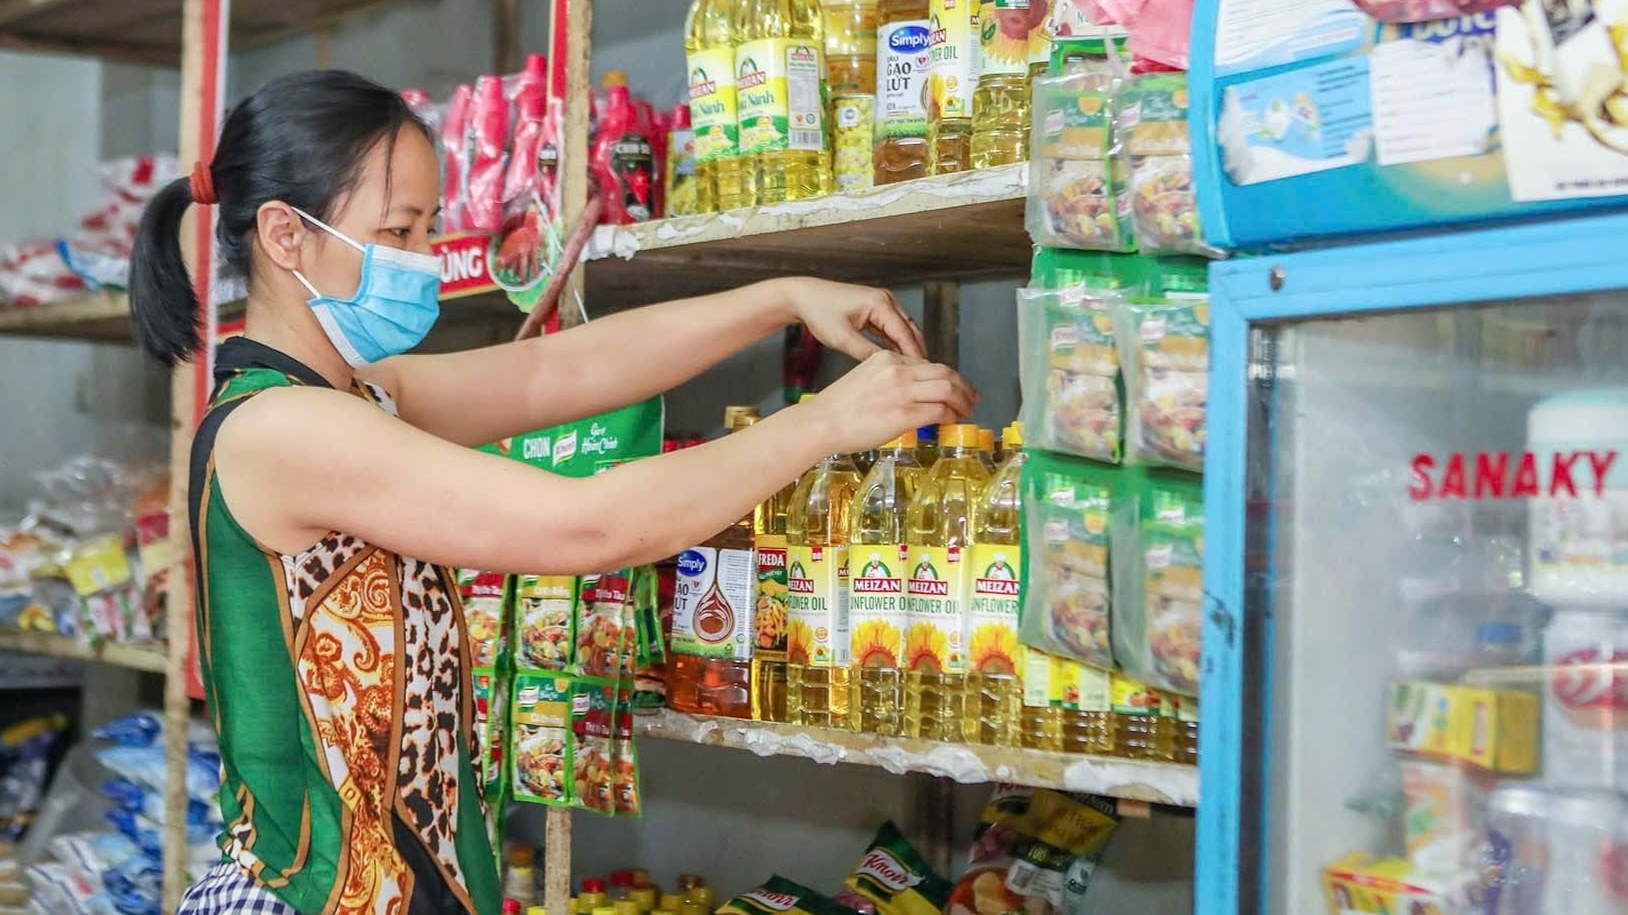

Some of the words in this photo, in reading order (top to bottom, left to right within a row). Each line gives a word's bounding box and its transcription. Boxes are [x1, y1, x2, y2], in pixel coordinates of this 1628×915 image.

[891, 33, 930, 51] Simply
[943, 46, 959, 60] OIL
[1407, 451, 1618, 501] SANAKY
[677, 556, 705, 572] Simply
[854, 580, 901, 591] MEIZAN
[908, 581, 947, 594] MEIZAN
[811, 597, 828, 611] OIL
[863, 853, 909, 885] Knorr
